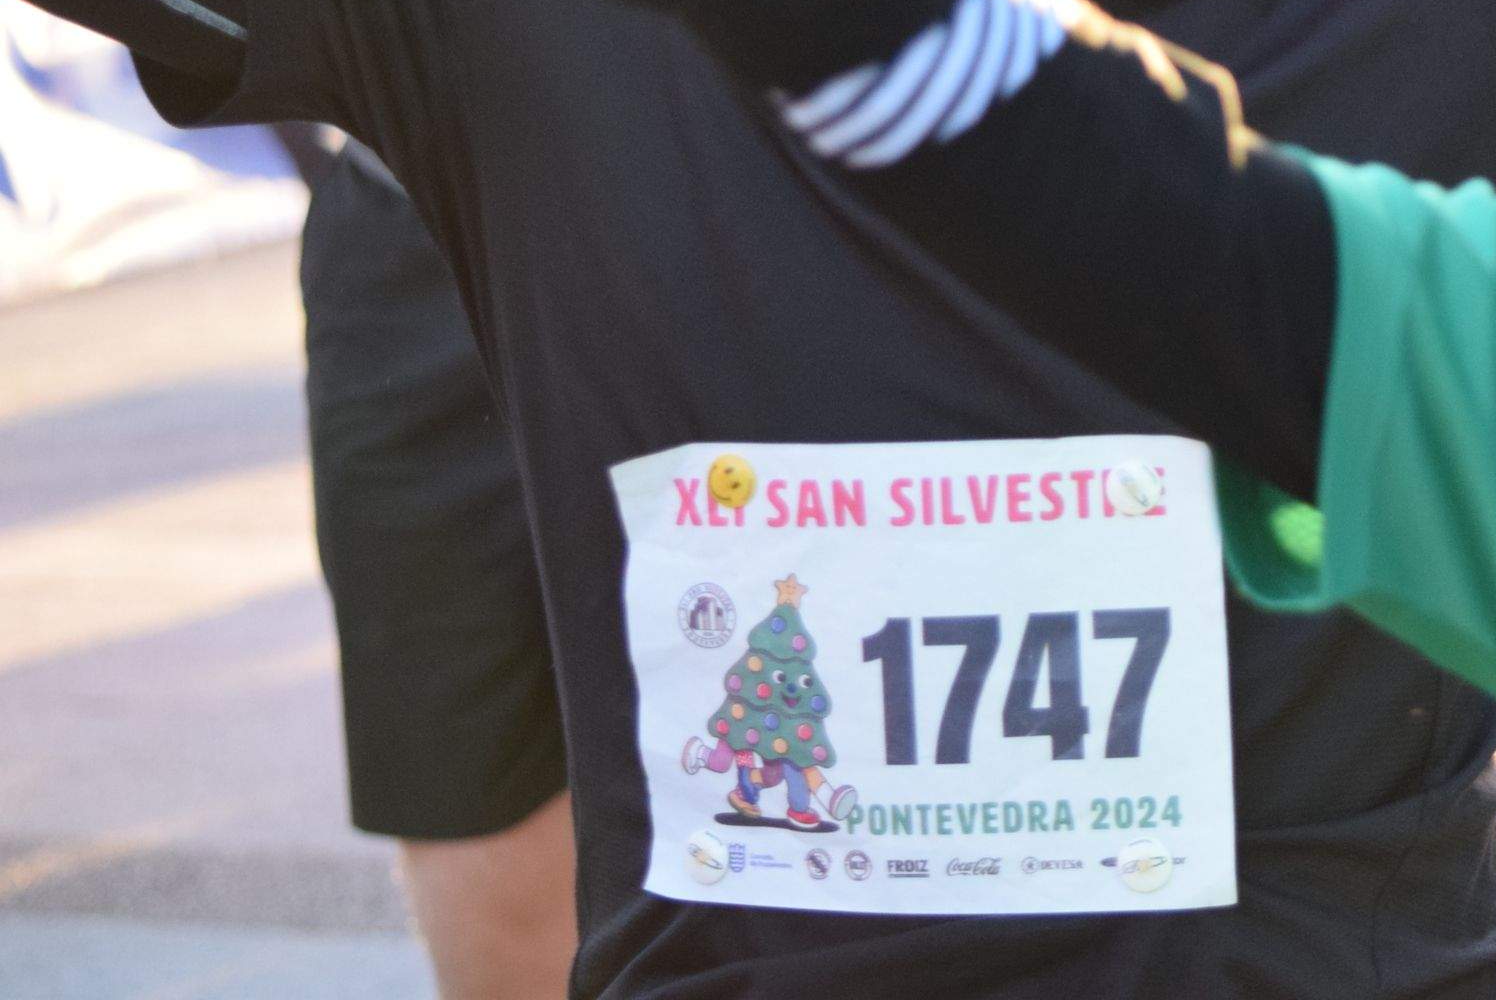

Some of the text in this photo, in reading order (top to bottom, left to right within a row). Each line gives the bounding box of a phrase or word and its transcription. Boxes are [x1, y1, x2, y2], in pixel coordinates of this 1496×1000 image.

[766, 478, 867, 528] SAN
[862, 607, 1171, 765] 1747
[848, 795, 1182, 835] PONTEVEDRA 2024
[887, 859, 929, 873] FROIZ
